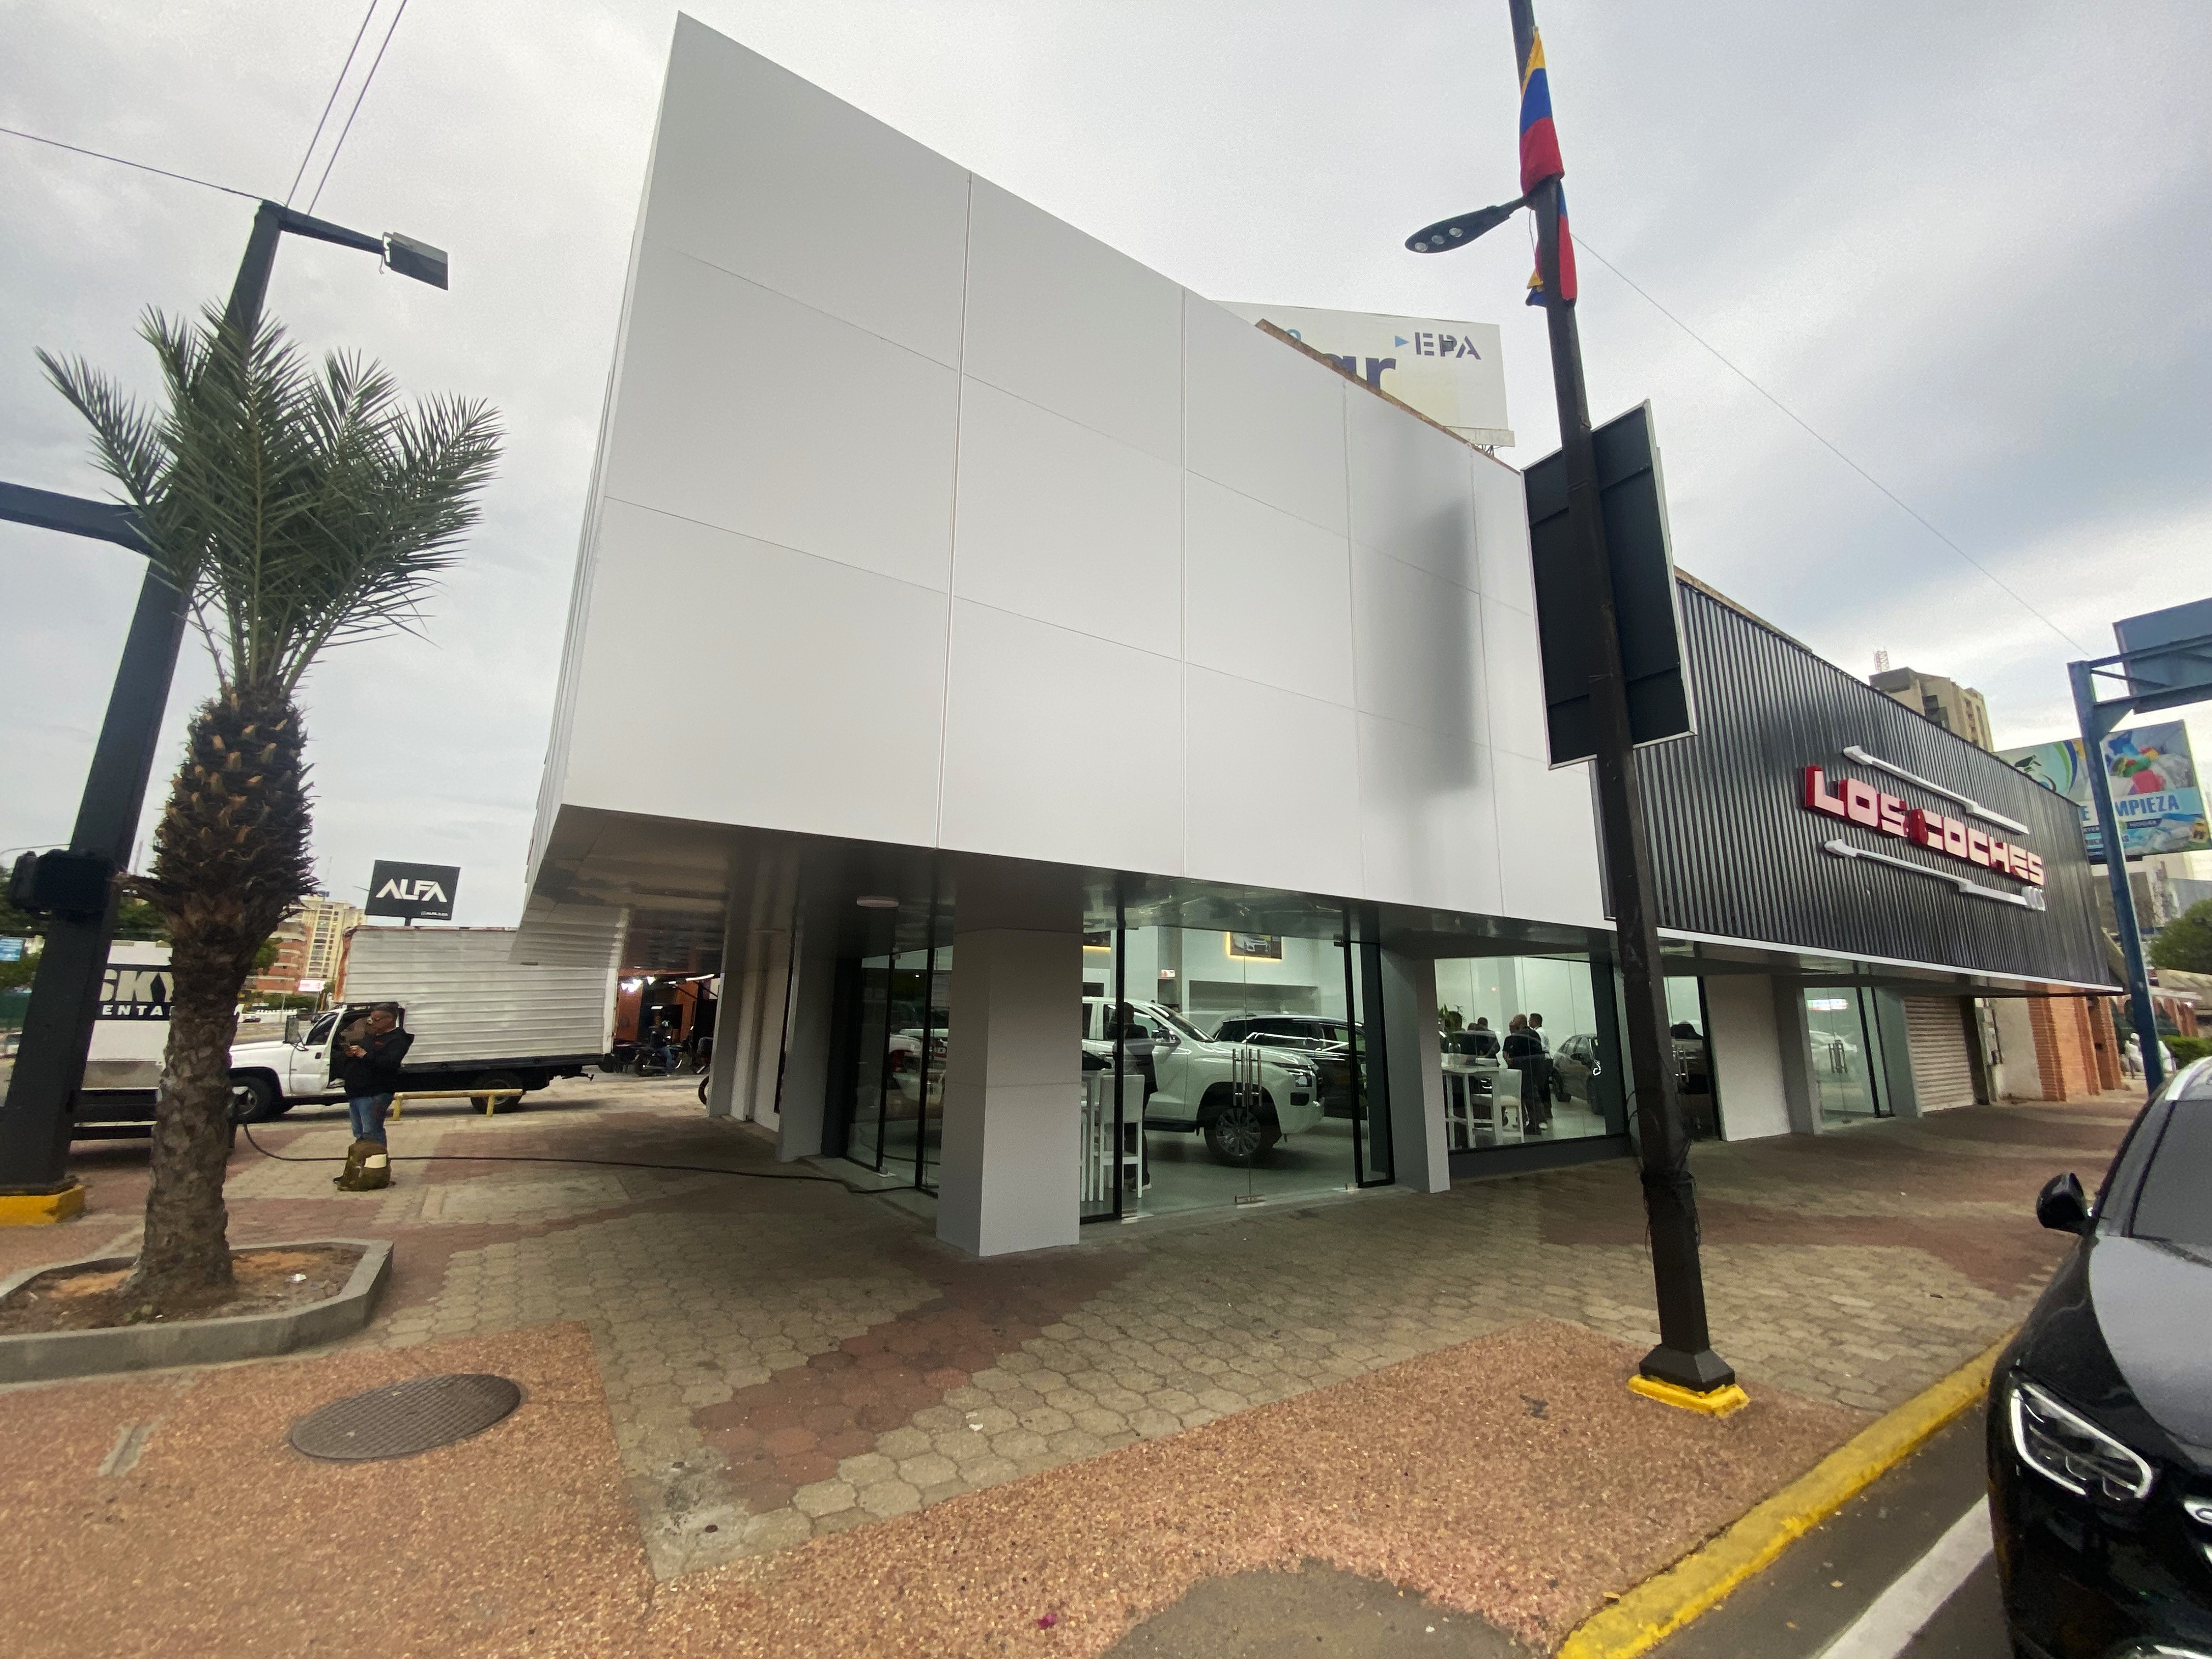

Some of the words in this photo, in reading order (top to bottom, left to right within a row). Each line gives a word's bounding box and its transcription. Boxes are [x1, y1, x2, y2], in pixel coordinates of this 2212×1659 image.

[1414, 331, 1482, 360] EPA
[2115, 794, 2180, 817] MPIEZA
[1805, 765, 1909, 838] LOS
[1910, 808, 2045, 885] COCHES
[375, 878, 448, 903] ALFA
[102, 1005, 176, 1016] ENTA
